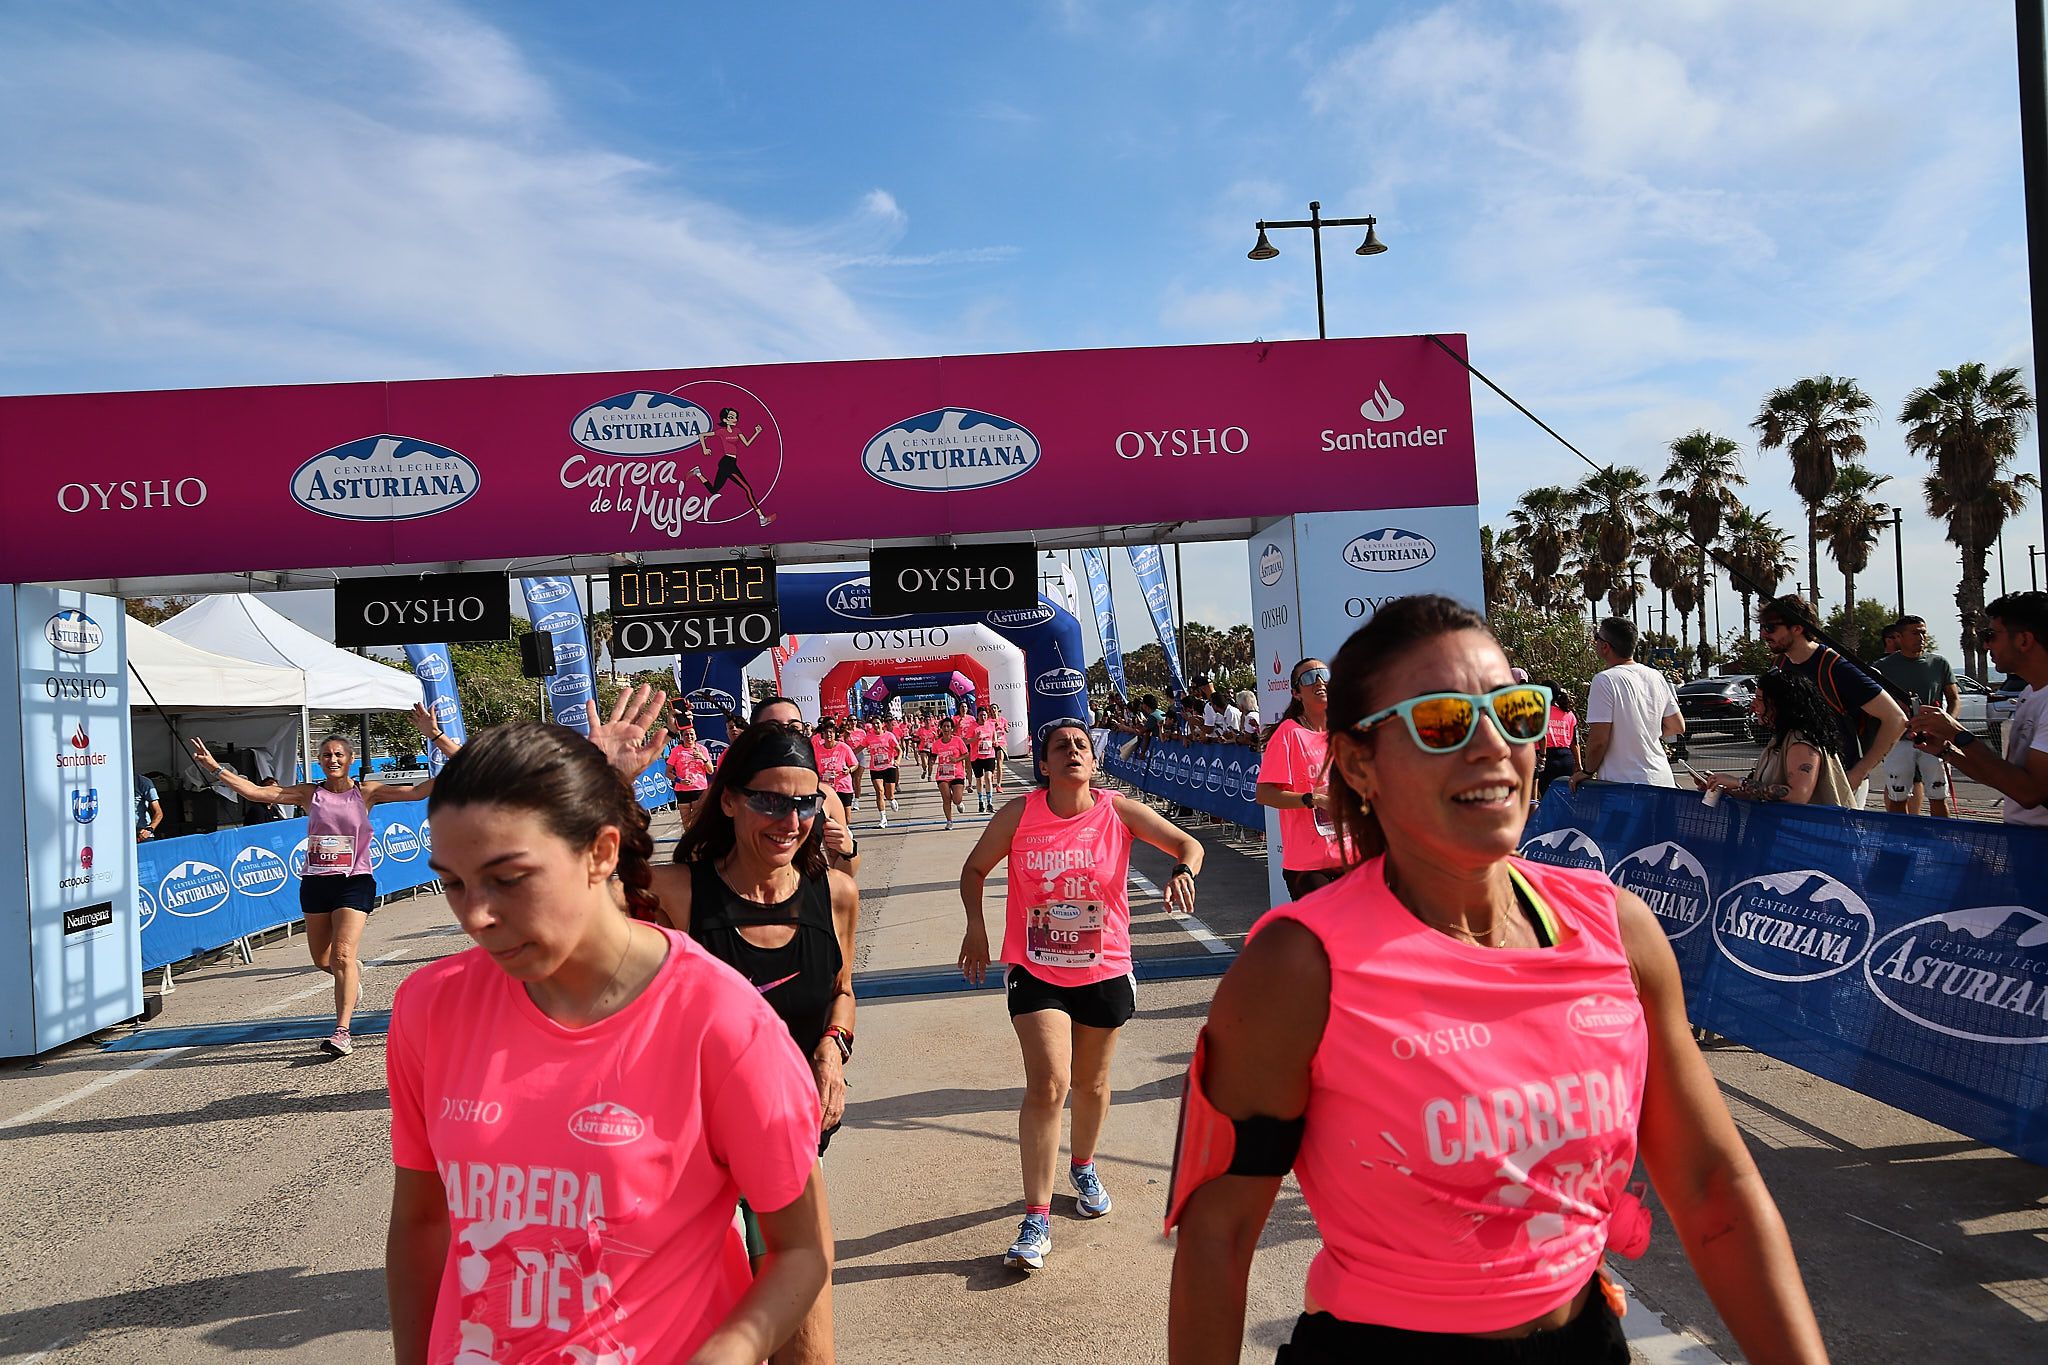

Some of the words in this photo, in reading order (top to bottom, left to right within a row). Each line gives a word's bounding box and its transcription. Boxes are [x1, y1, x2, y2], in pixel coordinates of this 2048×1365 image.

[582, 416, 701, 442] ASTURIANA
[603, 413, 648, 422] CENTRAL
[652, 410, 697, 419] LECHERA
[903, 436, 958, 447] CENTRAL
[964, 434, 1020, 444] LECHERA
[1115, 426, 1249, 460] OYSHO
[1320, 426, 1448, 452] Santander
[334, 464, 392, 475] CENTRAL
[399, 462, 459, 472] LECHERA
[876, 442, 1028, 472] ASTURIANA
[306, 469, 466, 500] ASTURIANA
[560, 455, 678, 488] Carrera
[57, 478, 207, 514] OYSHO
[590, 490, 613, 513] de
[616, 488, 633, 512] la
[630, 481, 722, 538] Mujer
[1350, 546, 1429, 562] ASTURIANA
[620, 566, 764, 606] 00:36:02
[898, 566, 1015, 593] OYSHO
[363, 596, 484, 626] OYSHO
[994, 610, 1051, 622] ASTURIANA
[1262, 604, 1288, 630] OYSHO
[50, 622, 100, 644] ASTURIANA
[621, 614, 772, 652] OYSHO
[852, 627, 949, 651] OYSHO
[796, 656, 825, 664] OYSHO
[976, 644, 1006, 652] OYSHO
[46, 677, 106, 698] OYSHO
[56, 752, 106, 768] Santander
[1026, 849, 1096, 870] CARRERA
[1533, 850, 1564, 866] CENTRAL
[238, 866, 285, 888] ASTURIANA
[1631, 870, 1663, 884] CENTRAL
[166, 881, 228, 908] ASTURIANA
[66, 909, 110, 928] Neutrogena
[1750, 896, 1799, 916] CENTRAL
[1802, 908, 1860, 931] LECHERA
[1050, 930, 1079, 942] 016
[1718, 895, 1852, 965] ASTURIANA
[1930, 938, 2002, 964] CENTRAL
[2010, 956, 2048, 975] LEC
[1392, 1023, 1491, 1060] OYSHO
[573, 1116, 637, 1137] ASTURIANA
[1424, 1064, 1634, 1166] CARRERA
[438, 1160, 608, 1231] ARRERA
